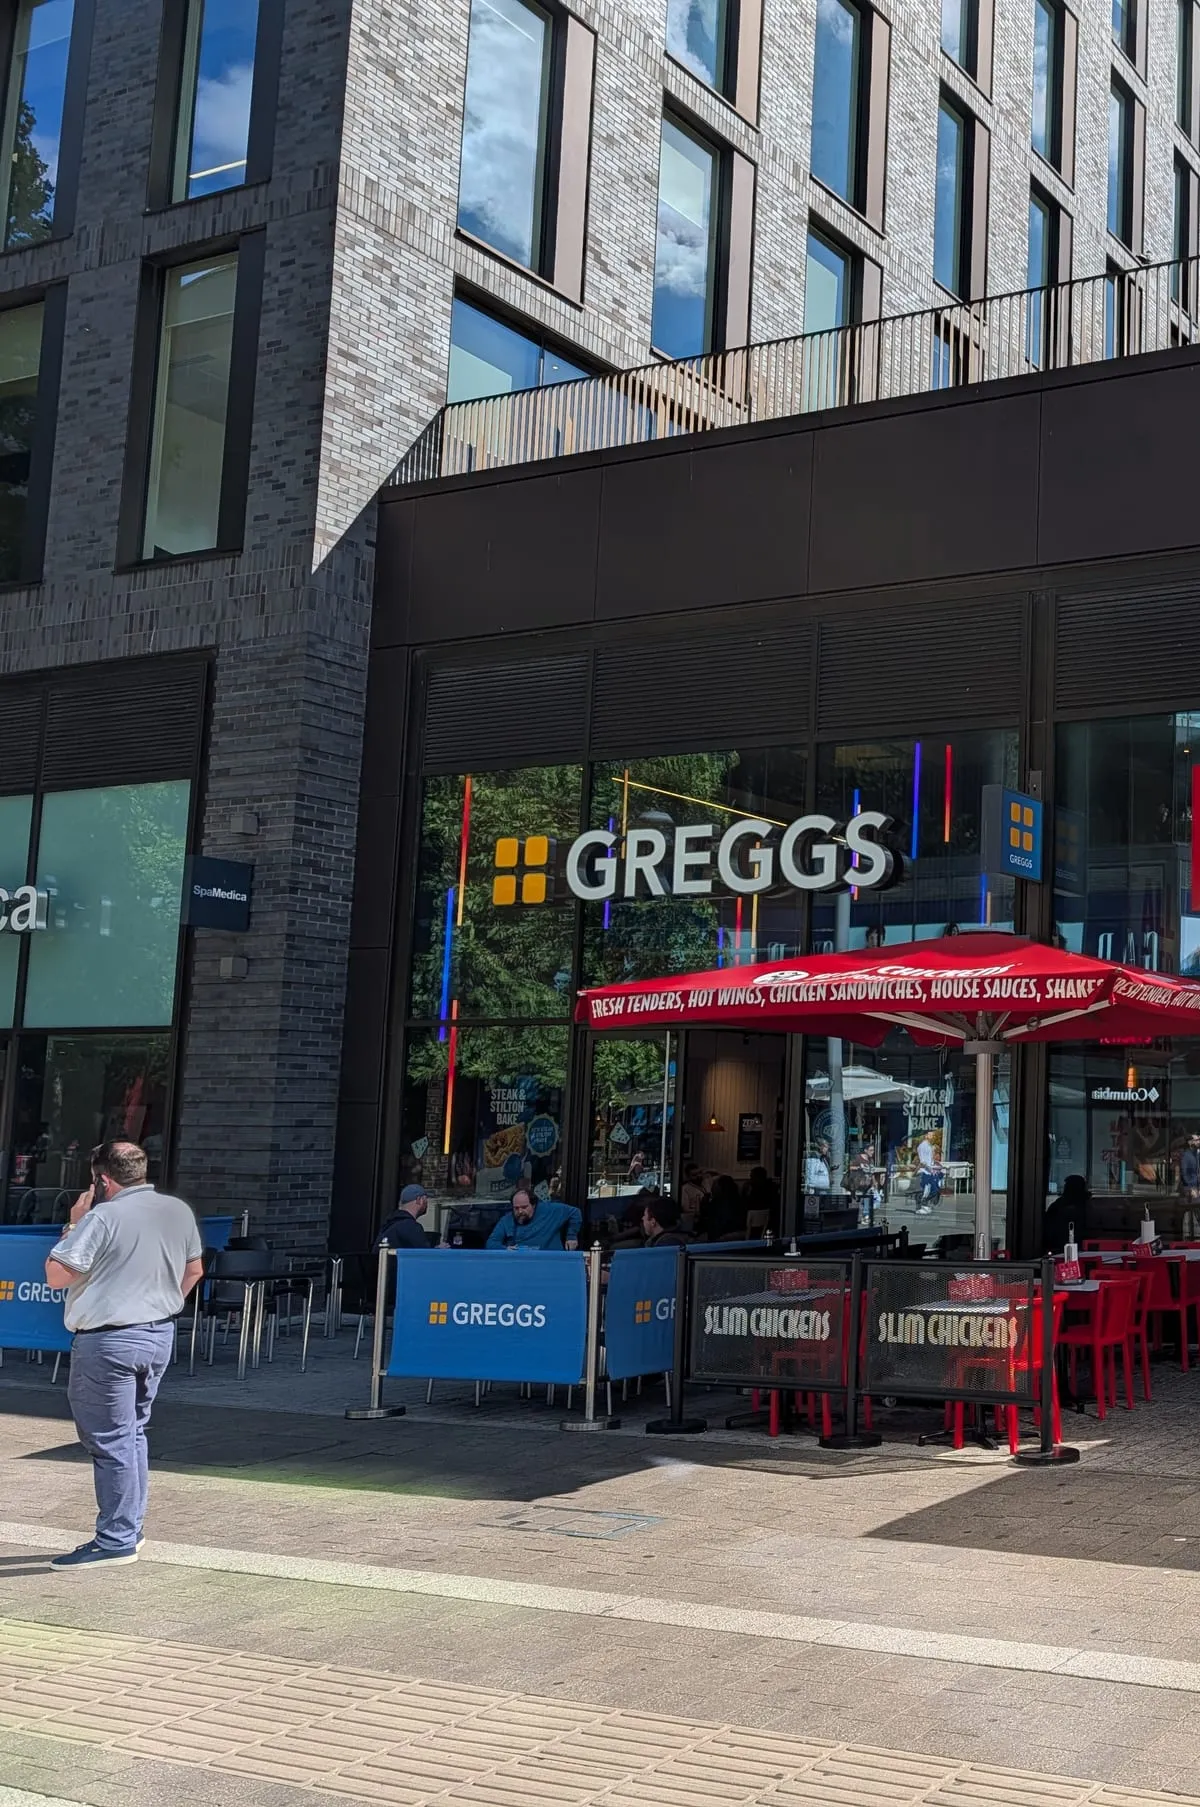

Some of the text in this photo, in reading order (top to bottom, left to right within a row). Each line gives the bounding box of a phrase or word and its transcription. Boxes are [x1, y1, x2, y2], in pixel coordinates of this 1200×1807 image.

[566, 810, 891, 901] GREGGS
[1009, 854, 1033, 869] GREGGS
[192, 884, 248, 902] SpaMedica
[591, 995, 624, 1019] FRESH
[628, 990, 685, 1013] TENDERS,
[688, 987, 714, 1008] HOT
[717, 985, 765, 1008] WINGS,
[769, 982, 827, 1003] CHICKEN
[830, 979, 928, 1004] SANDWICHES,
[930, 978, 981, 999] HOUSE
[982, 978, 1042, 1003] SAUCES,
[490, 1088, 527, 1100] STEAK &
[903, 1089, 946, 1103] STEAK &
[490, 1101, 524, 1113] STILTON
[902, 1103, 945, 1116] STILTON
[496, 1113, 519, 1125] BAKE
[911, 1117, 939, 1130] BAKE
[17, 1281, 67, 1304] GREG
[453, 1302, 546, 1328] GREGGS
[704, 1305, 748, 1337] SLIM
[749, 1307, 831, 1342] CHICKENS
[878, 1312, 1019, 1349] SLIM CHICKENS
